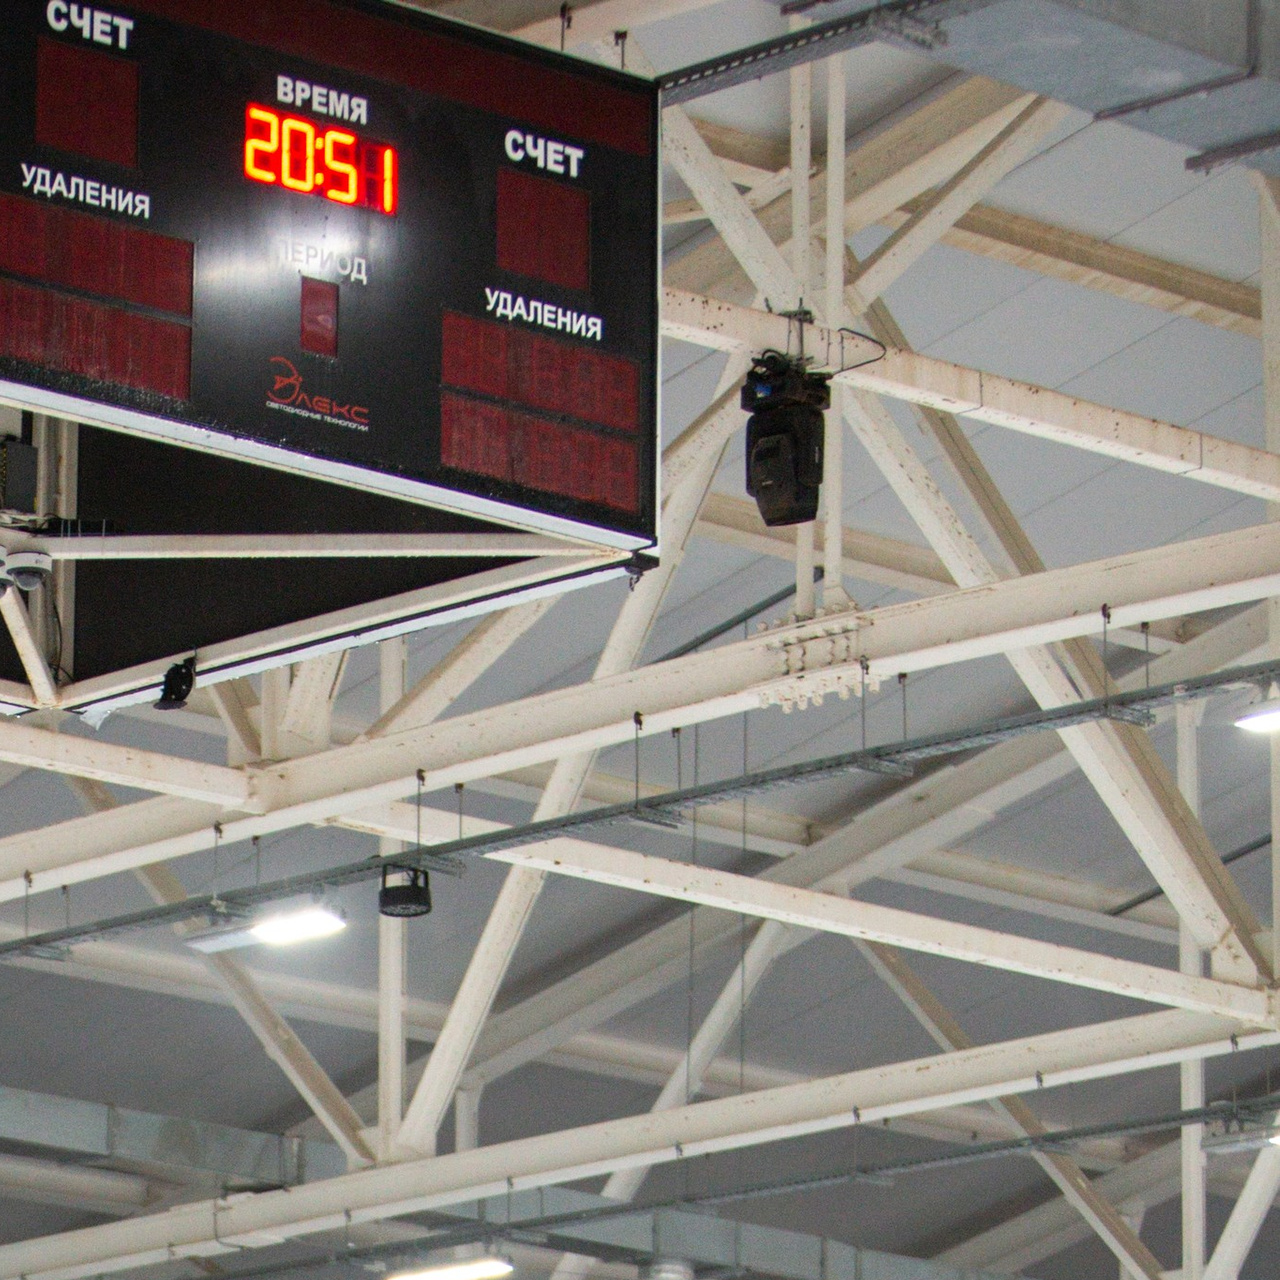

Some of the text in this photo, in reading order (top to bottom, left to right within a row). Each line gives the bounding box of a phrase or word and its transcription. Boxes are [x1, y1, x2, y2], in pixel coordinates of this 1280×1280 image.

[46, 0, 134, 50] СЧЕТ
[277, 75, 368, 125] ВРЕМЯ
[245, 107, 394, 213] 20:51
[504, 129, 585, 179] СЧЕТ
[21, 163, 151, 220] УДАЛЕНИЯ
[484, 287, 603, 342] УДАЛЕНИЯ
